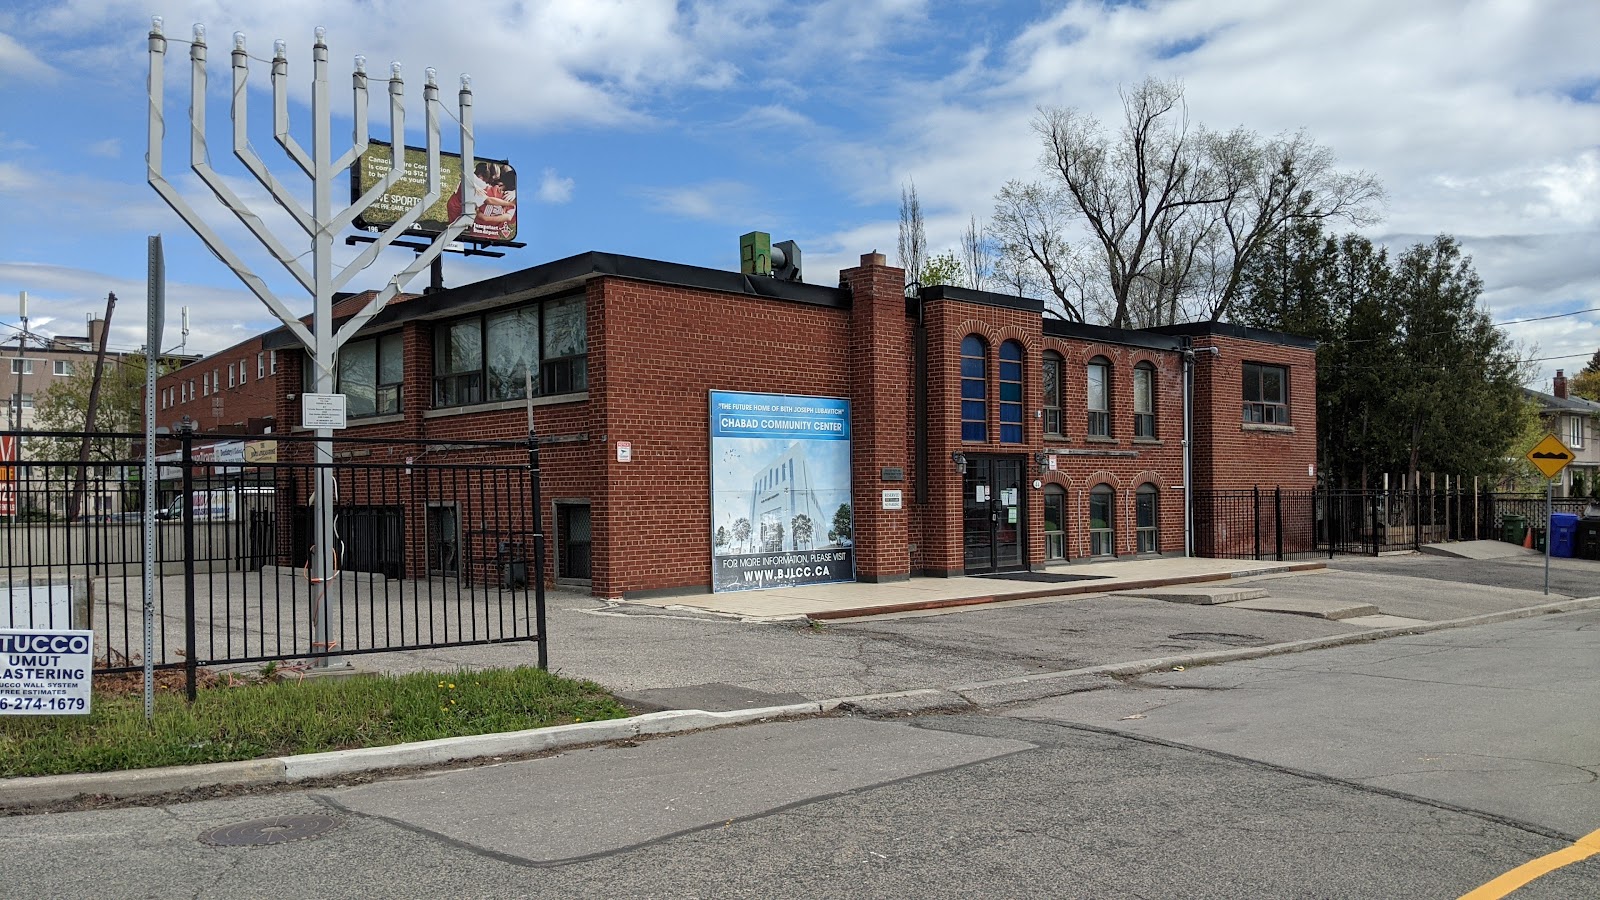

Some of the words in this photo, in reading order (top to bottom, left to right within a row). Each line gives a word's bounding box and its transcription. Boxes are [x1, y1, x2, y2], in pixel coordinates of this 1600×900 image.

[794, 406, 814, 414] JOSEPH
[721, 418, 759, 428] CHABAD
[761, 419, 812, 430] COMMUNITY
[814, 421, 842, 431] CENTER
[723, 560, 738, 568] FOR
[740, 557, 760, 567] MORE
[810, 553, 832, 562] PLEASE
[832, 552, 846, 561] VISIT
[744, 566, 830, 581] WWW.BJLCC.CA
[0, 636, 87, 653] TUCCO
[9, 655, 60, 666] UMUT
[0, 668, 84, 680] ASTERING
[0, 698, 85, 710] 6-274-1679
